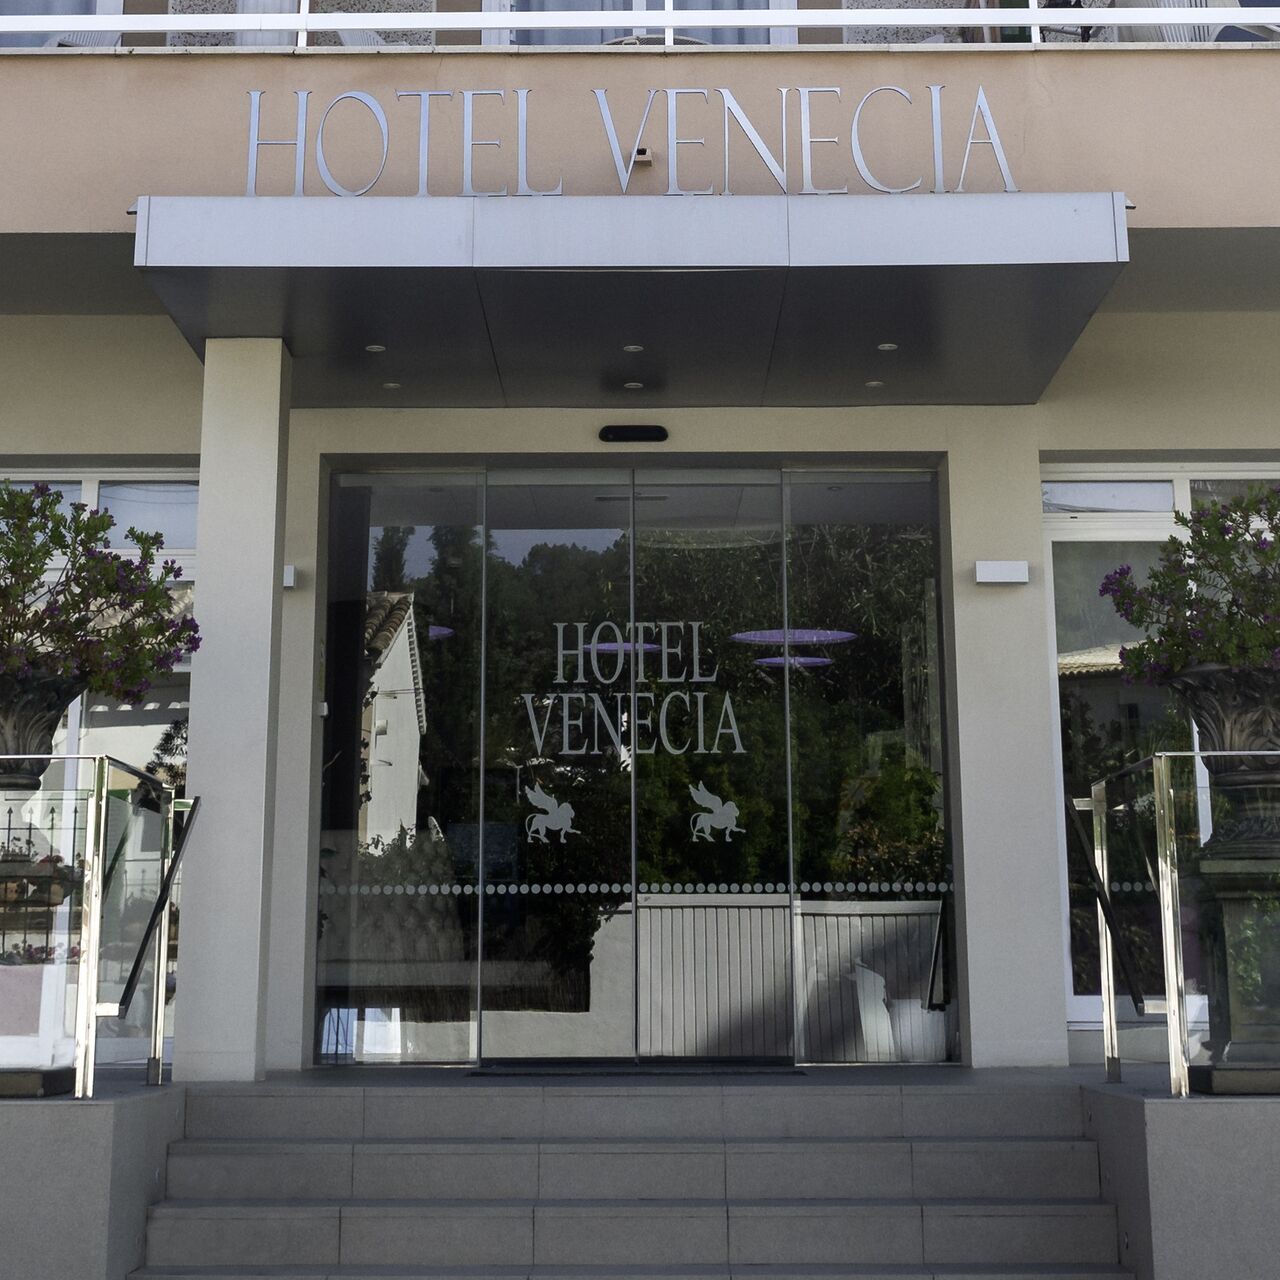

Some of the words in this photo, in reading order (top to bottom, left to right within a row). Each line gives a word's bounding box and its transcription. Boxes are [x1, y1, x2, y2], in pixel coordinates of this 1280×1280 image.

[245, 89, 564, 198] HOTEL
[592, 84, 1022, 197] VENECIA
[553, 621, 719, 684] HOTEL
[521, 690, 747, 756] VENECIA
